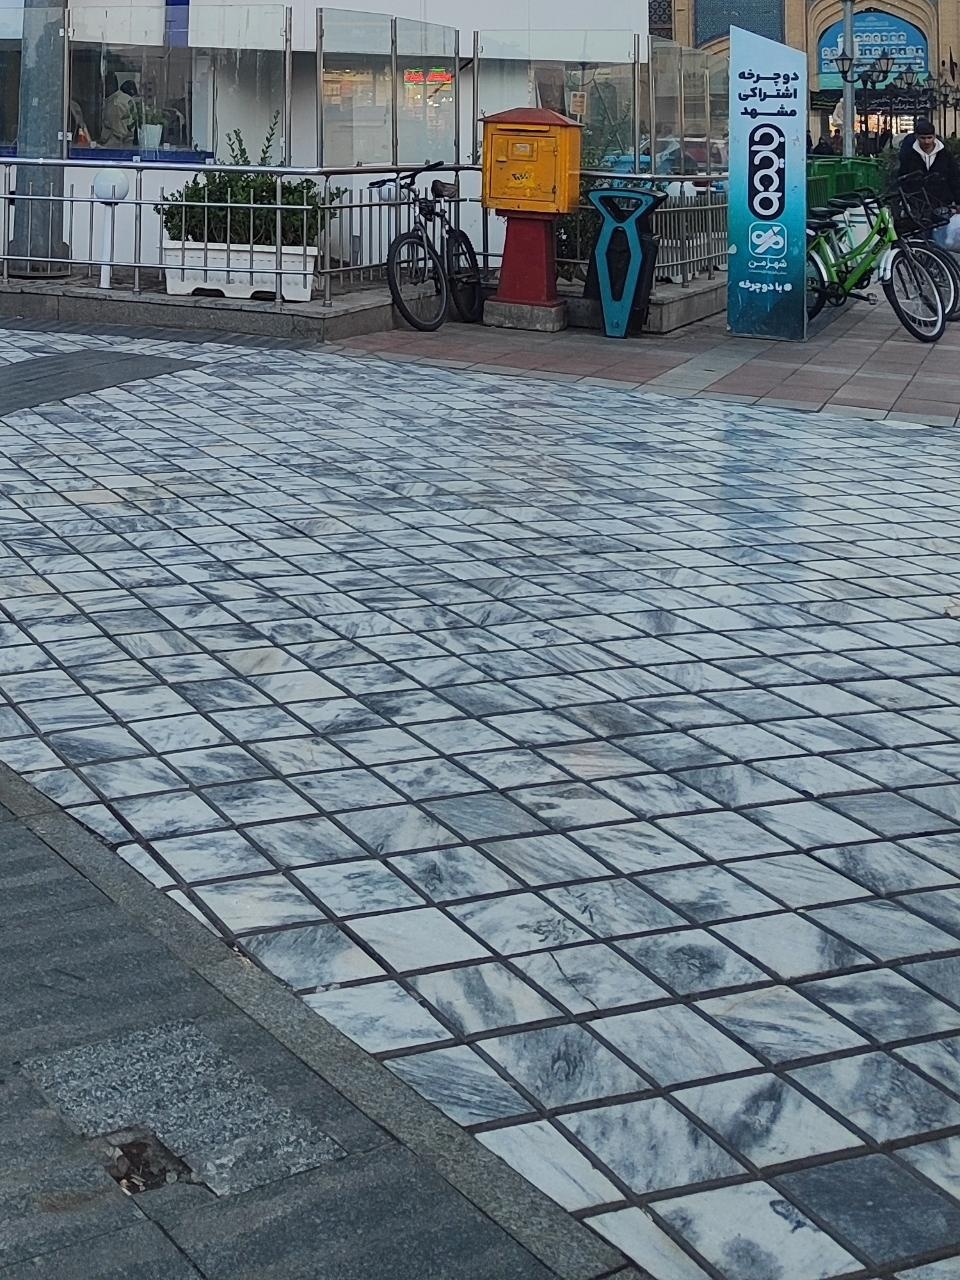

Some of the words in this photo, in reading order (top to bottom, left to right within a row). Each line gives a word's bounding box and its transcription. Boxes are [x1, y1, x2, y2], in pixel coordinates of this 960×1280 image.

[738, 69, 800, 87] دوچرخه
[737, 86, 798, 102] اشتراکی
[740, 104, 798, 119] مشهد
[738, 279, 775, 294] دوچرخه
